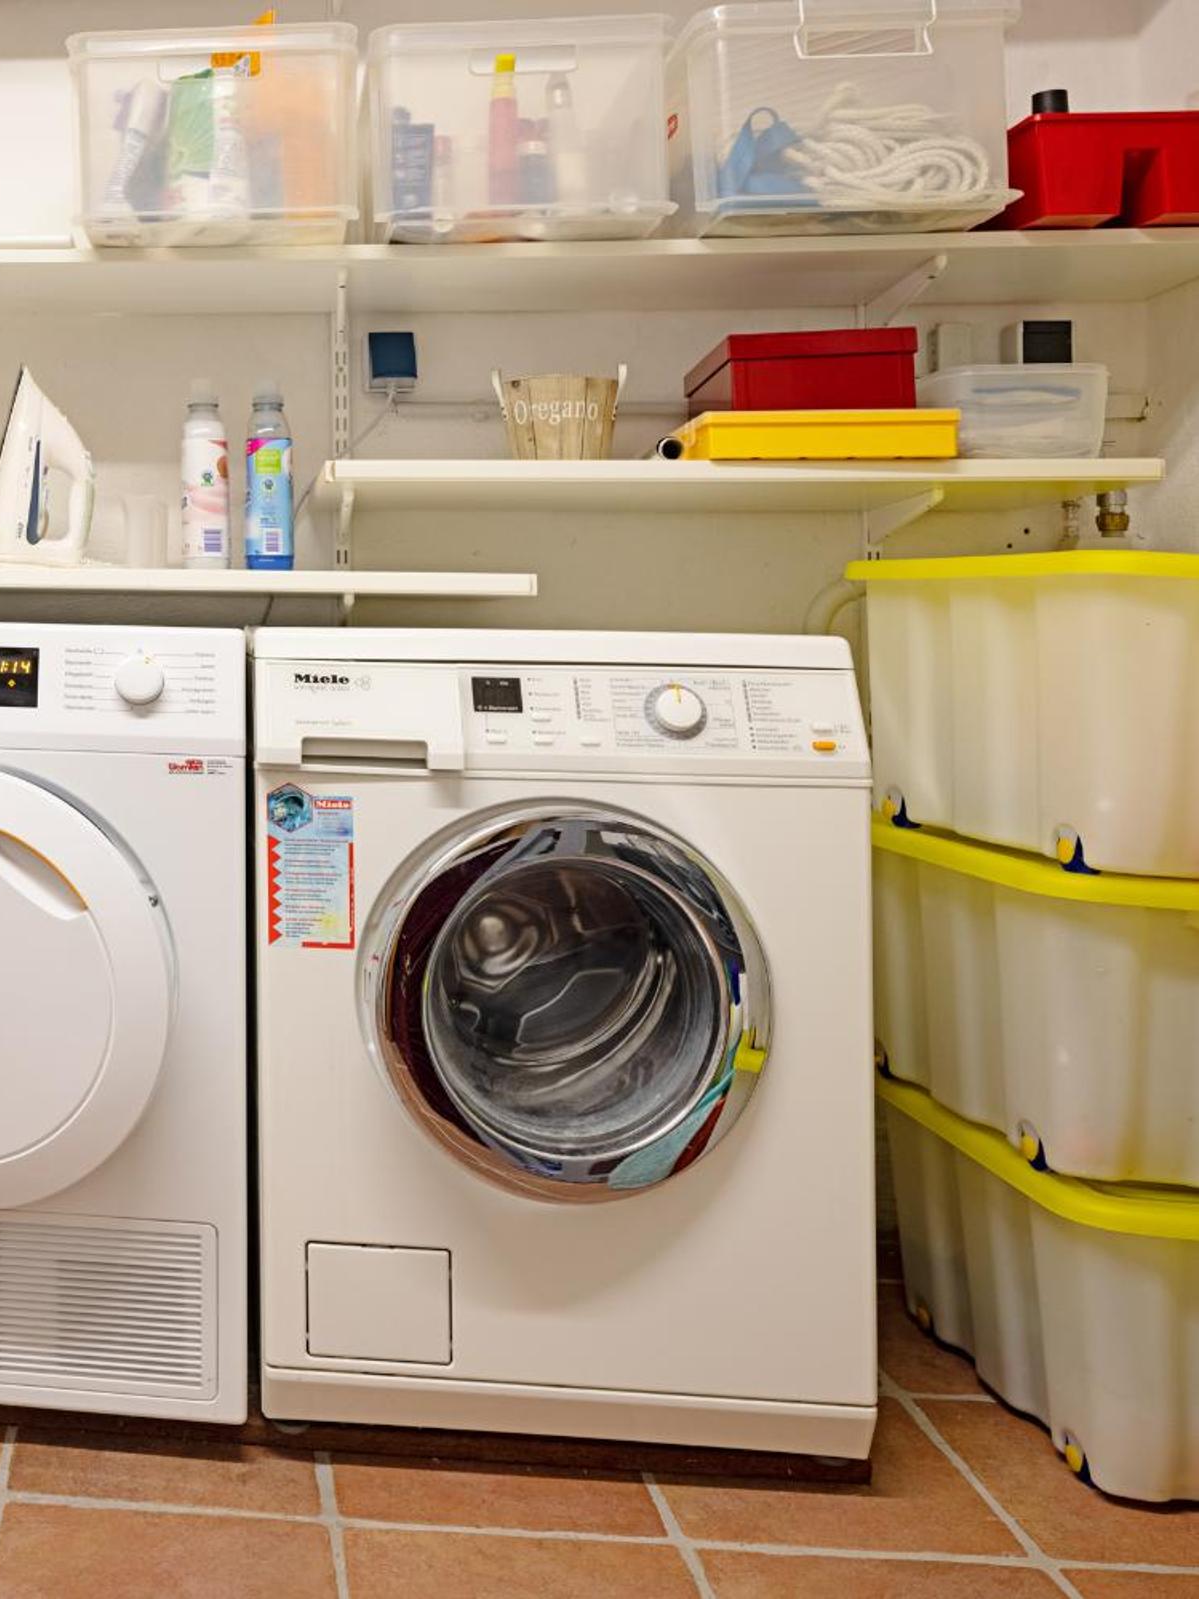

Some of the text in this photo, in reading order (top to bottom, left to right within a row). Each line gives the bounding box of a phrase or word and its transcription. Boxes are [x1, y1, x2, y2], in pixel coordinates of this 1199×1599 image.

[514, 400, 599, 425] Oregano
[294, 673, 350, 685] Miele
[315, 800, 351, 809] Miele
